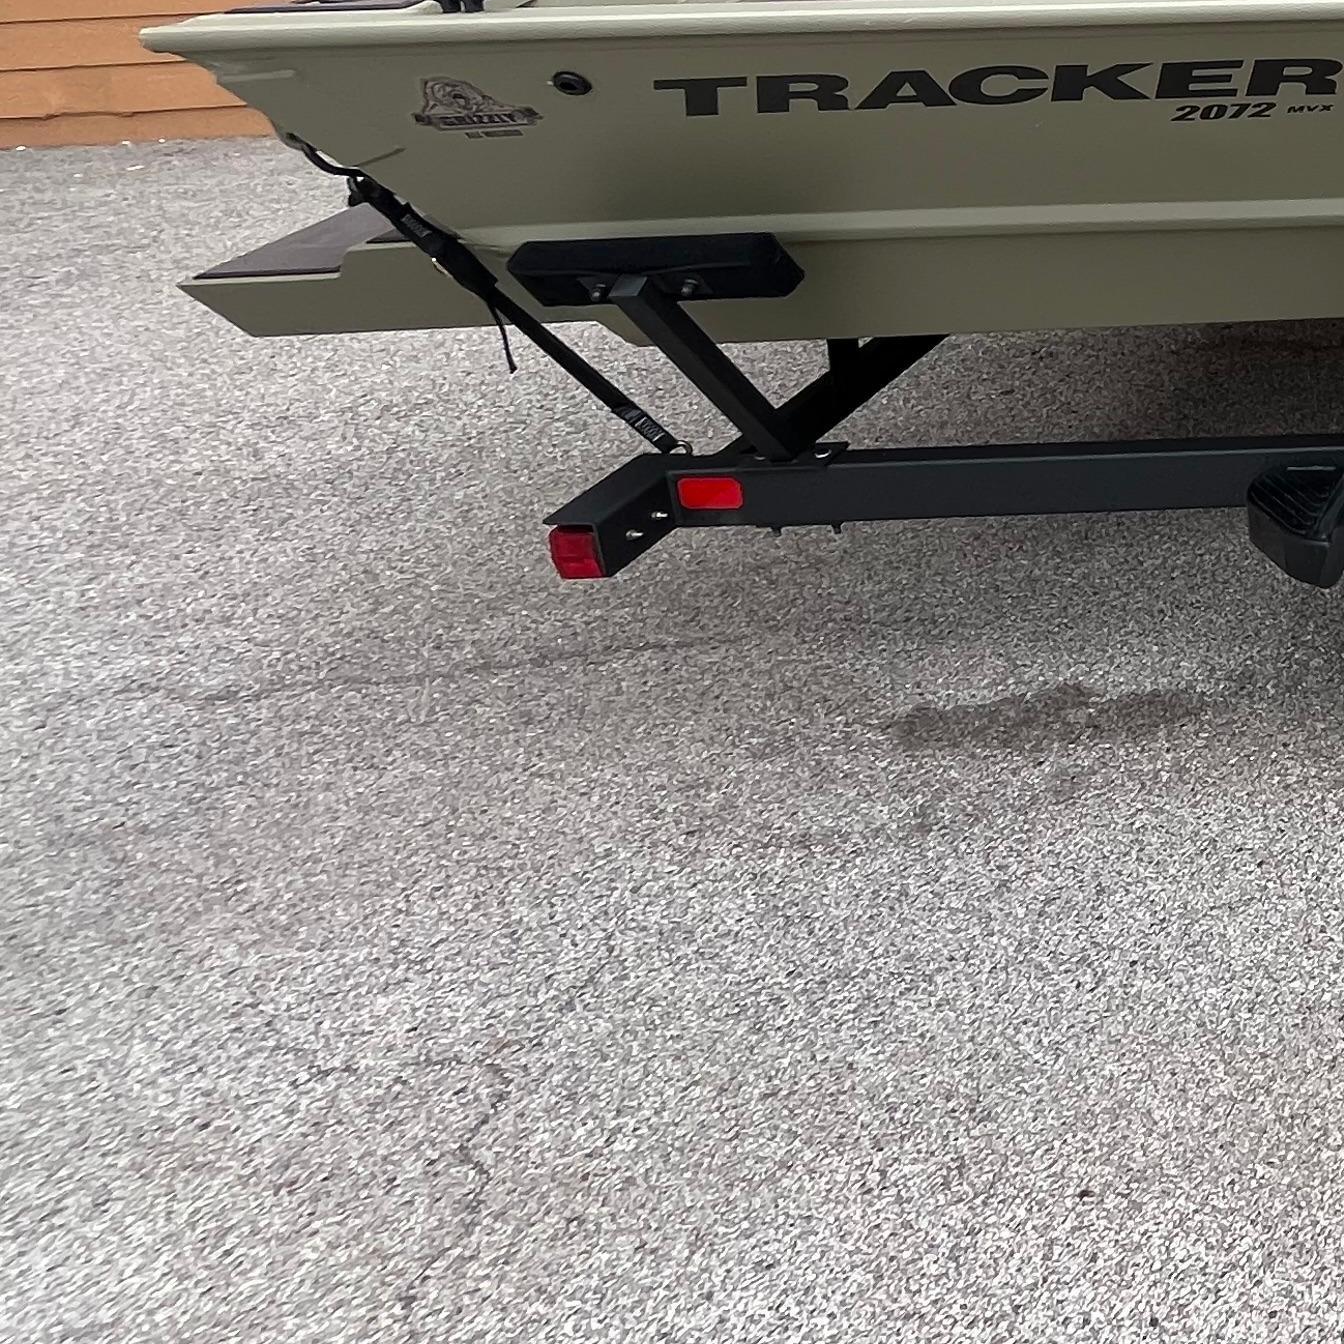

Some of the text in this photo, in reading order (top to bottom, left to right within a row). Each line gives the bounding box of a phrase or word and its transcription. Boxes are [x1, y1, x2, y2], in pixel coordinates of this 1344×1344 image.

[653, 58, 1344, 117] TRACKER
[1170, 101, 1335, 122] 2072 MVX
